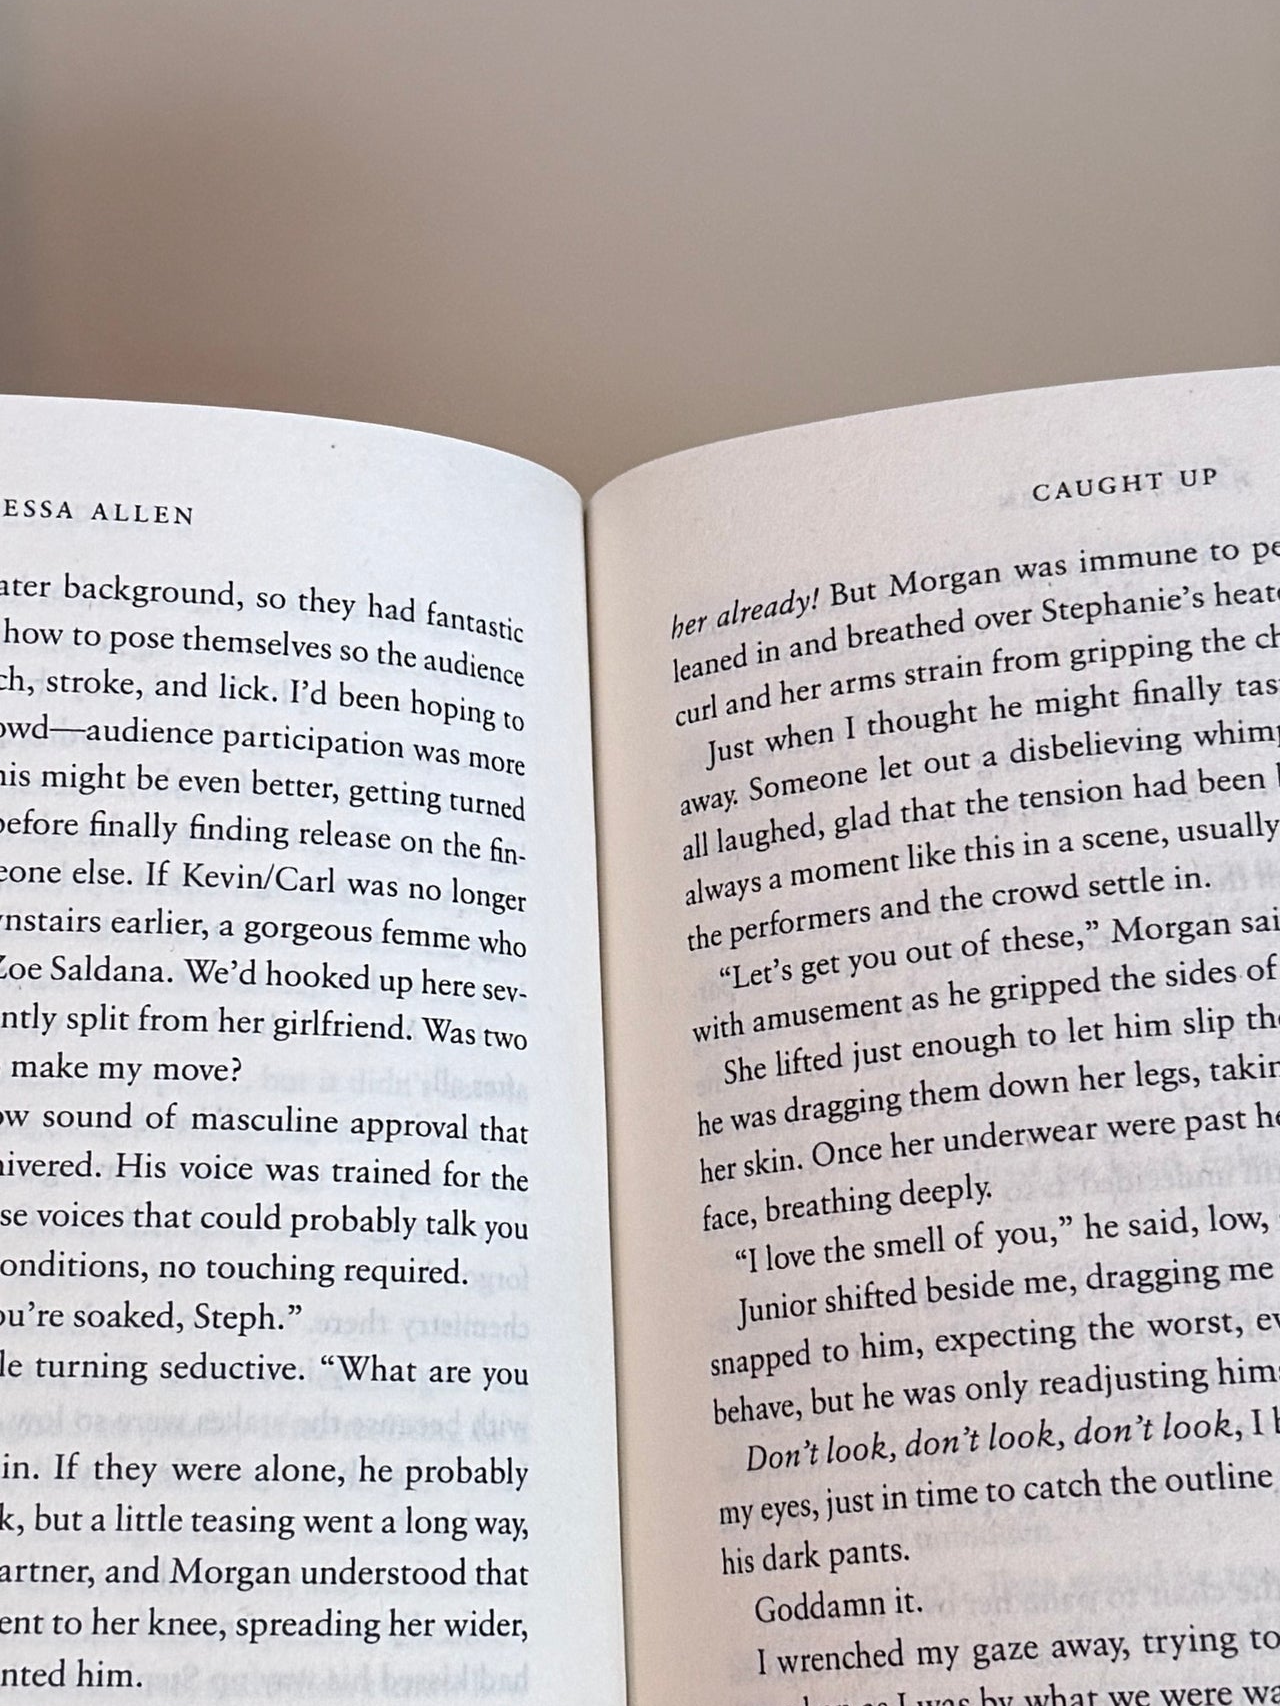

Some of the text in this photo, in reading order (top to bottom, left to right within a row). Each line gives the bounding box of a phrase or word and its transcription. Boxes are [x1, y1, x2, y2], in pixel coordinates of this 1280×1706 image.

[1031, 466, 1219, 503] CAUGHT UP
[89, 501, 194, 527] ALLEN
[63, 570, 245, 613] background,
[255, 590, 288, 611] so
[297, 585, 358, 623] they
[366, 591, 417, 624] had
[425, 599, 525, 645] fantastic
[670, 612, 709, 641] her
[715, 585, 821, 629] already!
[828, 581, 878, 608] But
[887, 566, 1003, 599] Morgan
[1012, 558, 1069, 581] was
[1078, 545, 1199, 575] immune
[1208, 542, 1241, 563] to
[221, 723, 406, 760] participation
[411, 742, 462, 767] was
[467, 750, 527, 778] more
[681, 829, 710, 863] all
[715, 810, 826, 855] laughed,
[833, 798, 892, 841] glad
[899, 795, 957, 825] that
[963, 786, 1011, 817] the
[1017, 778, 1125, 811] tension
[1131, 767, 1189, 800] had
[1196, 766, 1268, 795] been
[35, 1199, 126, 1229] voices
[131, 1199, 194, 1230] that
[199, 1201, 283, 1232] could
[288, 1203, 418, 1242] probably
[425, 1207, 479, 1238] talk
[483, 1219, 530, 1246] you
[735, 1291, 819, 1333] Junior
[824, 1275, 919, 1315] shifted
[924, 1268, 1016, 1305] beside
[1022, 1273, 1078, 1298] me,
[1084, 1257, 1223, 1296] dragging
[1227, 1260, 1275, 1283] me
[753, 1585, 924, 1625] Goddamn it.
[756, 1647, 768, 1677] I
[775, 1635, 906, 1675] wrenched
[915, 1644, 961, 1673] my
[971, 1639, 1040, 1672] gaze
[1050, 1635, 1132, 1665] away,
[1141, 1622, 1240, 1663] trying
